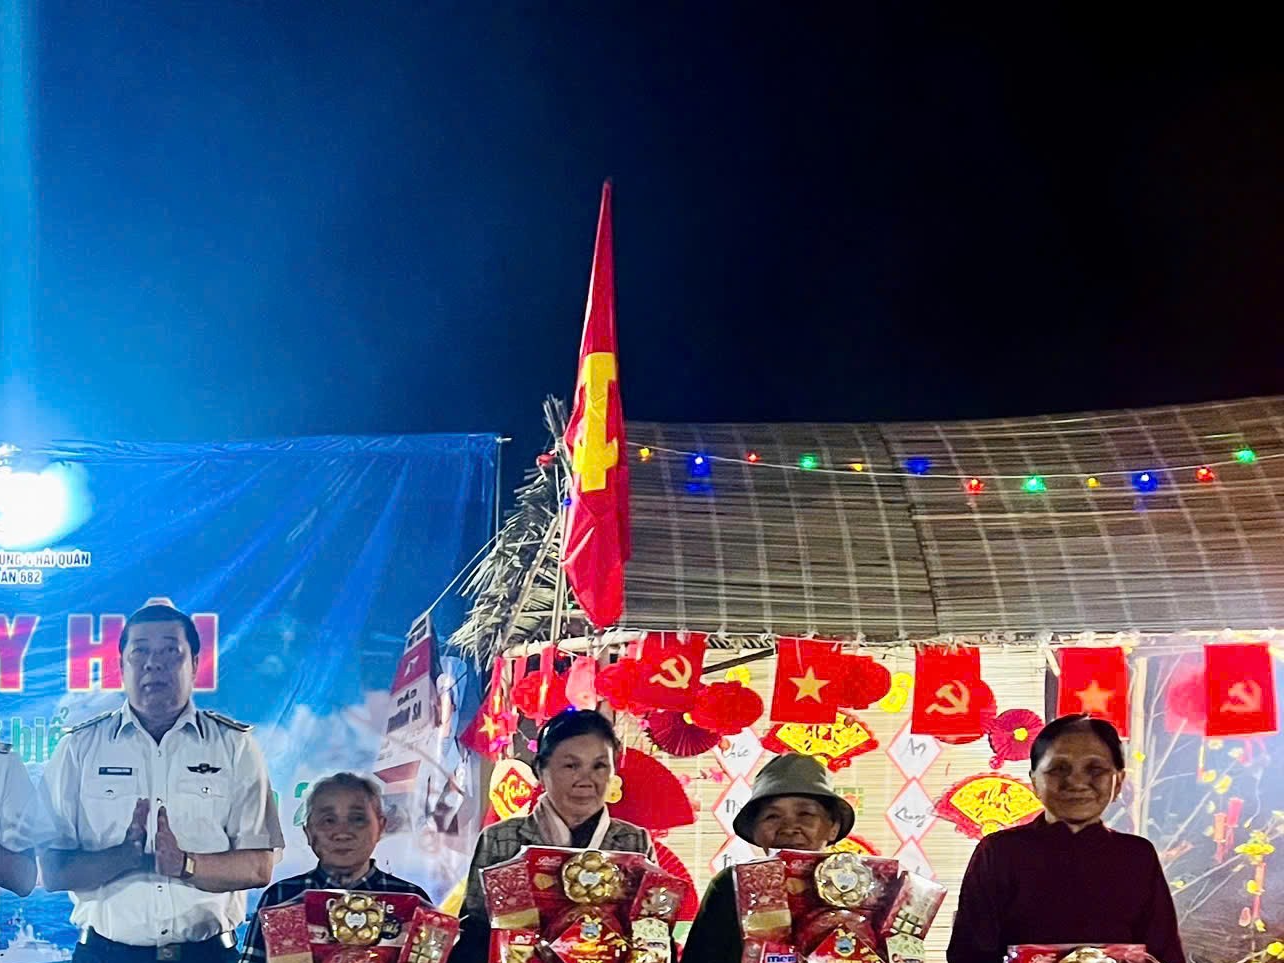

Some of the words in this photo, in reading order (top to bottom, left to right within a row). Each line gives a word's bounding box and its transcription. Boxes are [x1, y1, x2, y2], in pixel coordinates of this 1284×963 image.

[58, 549, 90, 568] QUÂN
[20, 570, 42, 583] 682
[68, 597, 218, 692] HI
